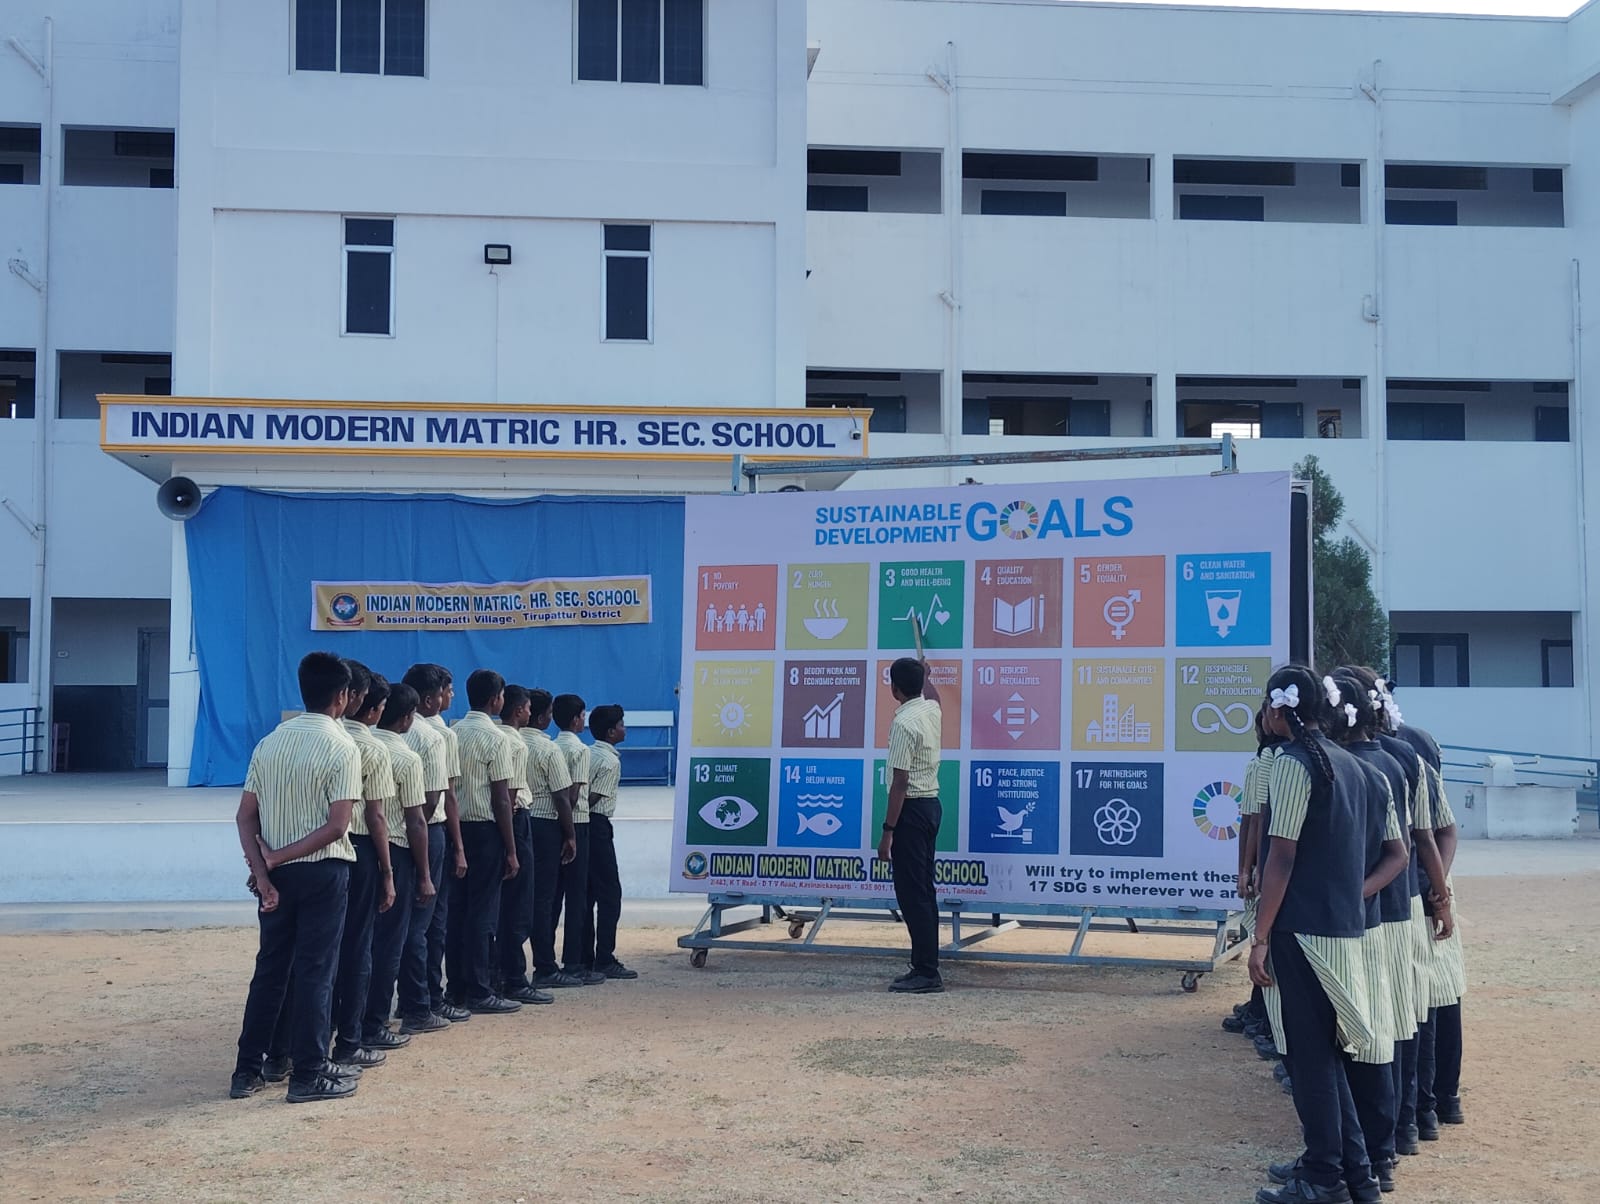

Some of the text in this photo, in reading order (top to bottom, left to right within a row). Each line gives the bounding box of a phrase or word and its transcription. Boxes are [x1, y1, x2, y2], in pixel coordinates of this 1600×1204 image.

[132, 410, 836, 448] INDIAN MODERN MATRIC HR. SEC. SCHOOL
[815, 503, 962, 525] SUSTAINABLE
[966, 496, 1134, 542] GOALS
[815, 525, 961, 546] DEVELOPMENT
[901, 568, 942, 576] GOOD HEALTH
[997, 566, 1024, 574] QUALITY
[1096, 563, 1122, 572] GENDER
[1183, 561, 1194, 581] 6
[1200, 560, 1245, 569] CLEAN WATER
[702, 572, 709, 590] 1
[793, 570, 802, 589] 2
[885, 568, 896, 587] 3
[980, 566, 992, 585] 4
[997, 576, 1032, 585] EDUCATION
[1080, 564, 1090, 583] 5
[1096, 574, 1127, 583] EQUALITY
[1200, 570, 1255, 580] AND SANITATION
[713, 582, 738, 590] POVERTY
[900, 578, 951, 587] AND WELL-BEING
[366, 590, 640, 612] INDIAN MODERN MATRIC. HR. SEC. SCHOOL
[376, 610, 622, 626] Kasinaickanpatti Village, Tirupattur District
[701, 667, 708, 685] 7
[790, 667, 799, 686] 8
[804, 667, 856, 675] DECENT WORK AND
[882, 666, 892, 686] 9
[977, 666, 994, 686] 10
[1000, 666, 1029, 674] REDUCED
[1078, 665, 1092, 685] 11
[1181, 664, 1199, 685] 12
[1205, 664, 1248, 673] RESPONSIBLE
[804, 677, 860, 686] ECONOMIC GROWTH
[1000, 677, 1040, 686] INEQUALITIES
[1205, 675, 1252, 684] CONSUMPTION
[1205, 687, 1262, 696] AND PRODUCTION
[694, 764, 710, 783] 13
[714, 764, 738, 773] CLIMATE
[784, 765, 800, 784] 14
[806, 766, 817, 774] LIFE
[878, 766, 885, 785] 1
[998, 768, 1044, 778] PEACE, JUSTICE
[1100, 769, 1148, 778] PARTNERSHIPS
[714, 775, 734, 783] ACTION
[806, 776, 846, 785] BELOW WATER
[975, 768, 992, 787] 16
[998, 779, 1037, 788] AND STRONG
[1075, 769, 1093, 789] 17
[1100, 780, 1148, 790] FOR THE GOALS
[998, 790, 1040, 799] INSTITUTIONS
[711, 853, 754, 878] INDIAN
[758, 854, 812, 879] MODERN
[814, 855, 867, 882] MATRIC.
[934, 859, 988, 886] SCHOOL
[1026, 864, 1054, 878] Will
[1060, 866, 1083, 880] try
[1088, 867, 1104, 879] to
[1110, 868, 1198, 882] implement
[1204, 870, 1238, 883] thes
[1030, 880, 1047, 892] 17
[1053, 882, 1086, 894] SDG
[1107, 884, 1184, 897] wherever
[1190, 888, 1214, 898] we
[1220, 889, 1237, 899] ar
